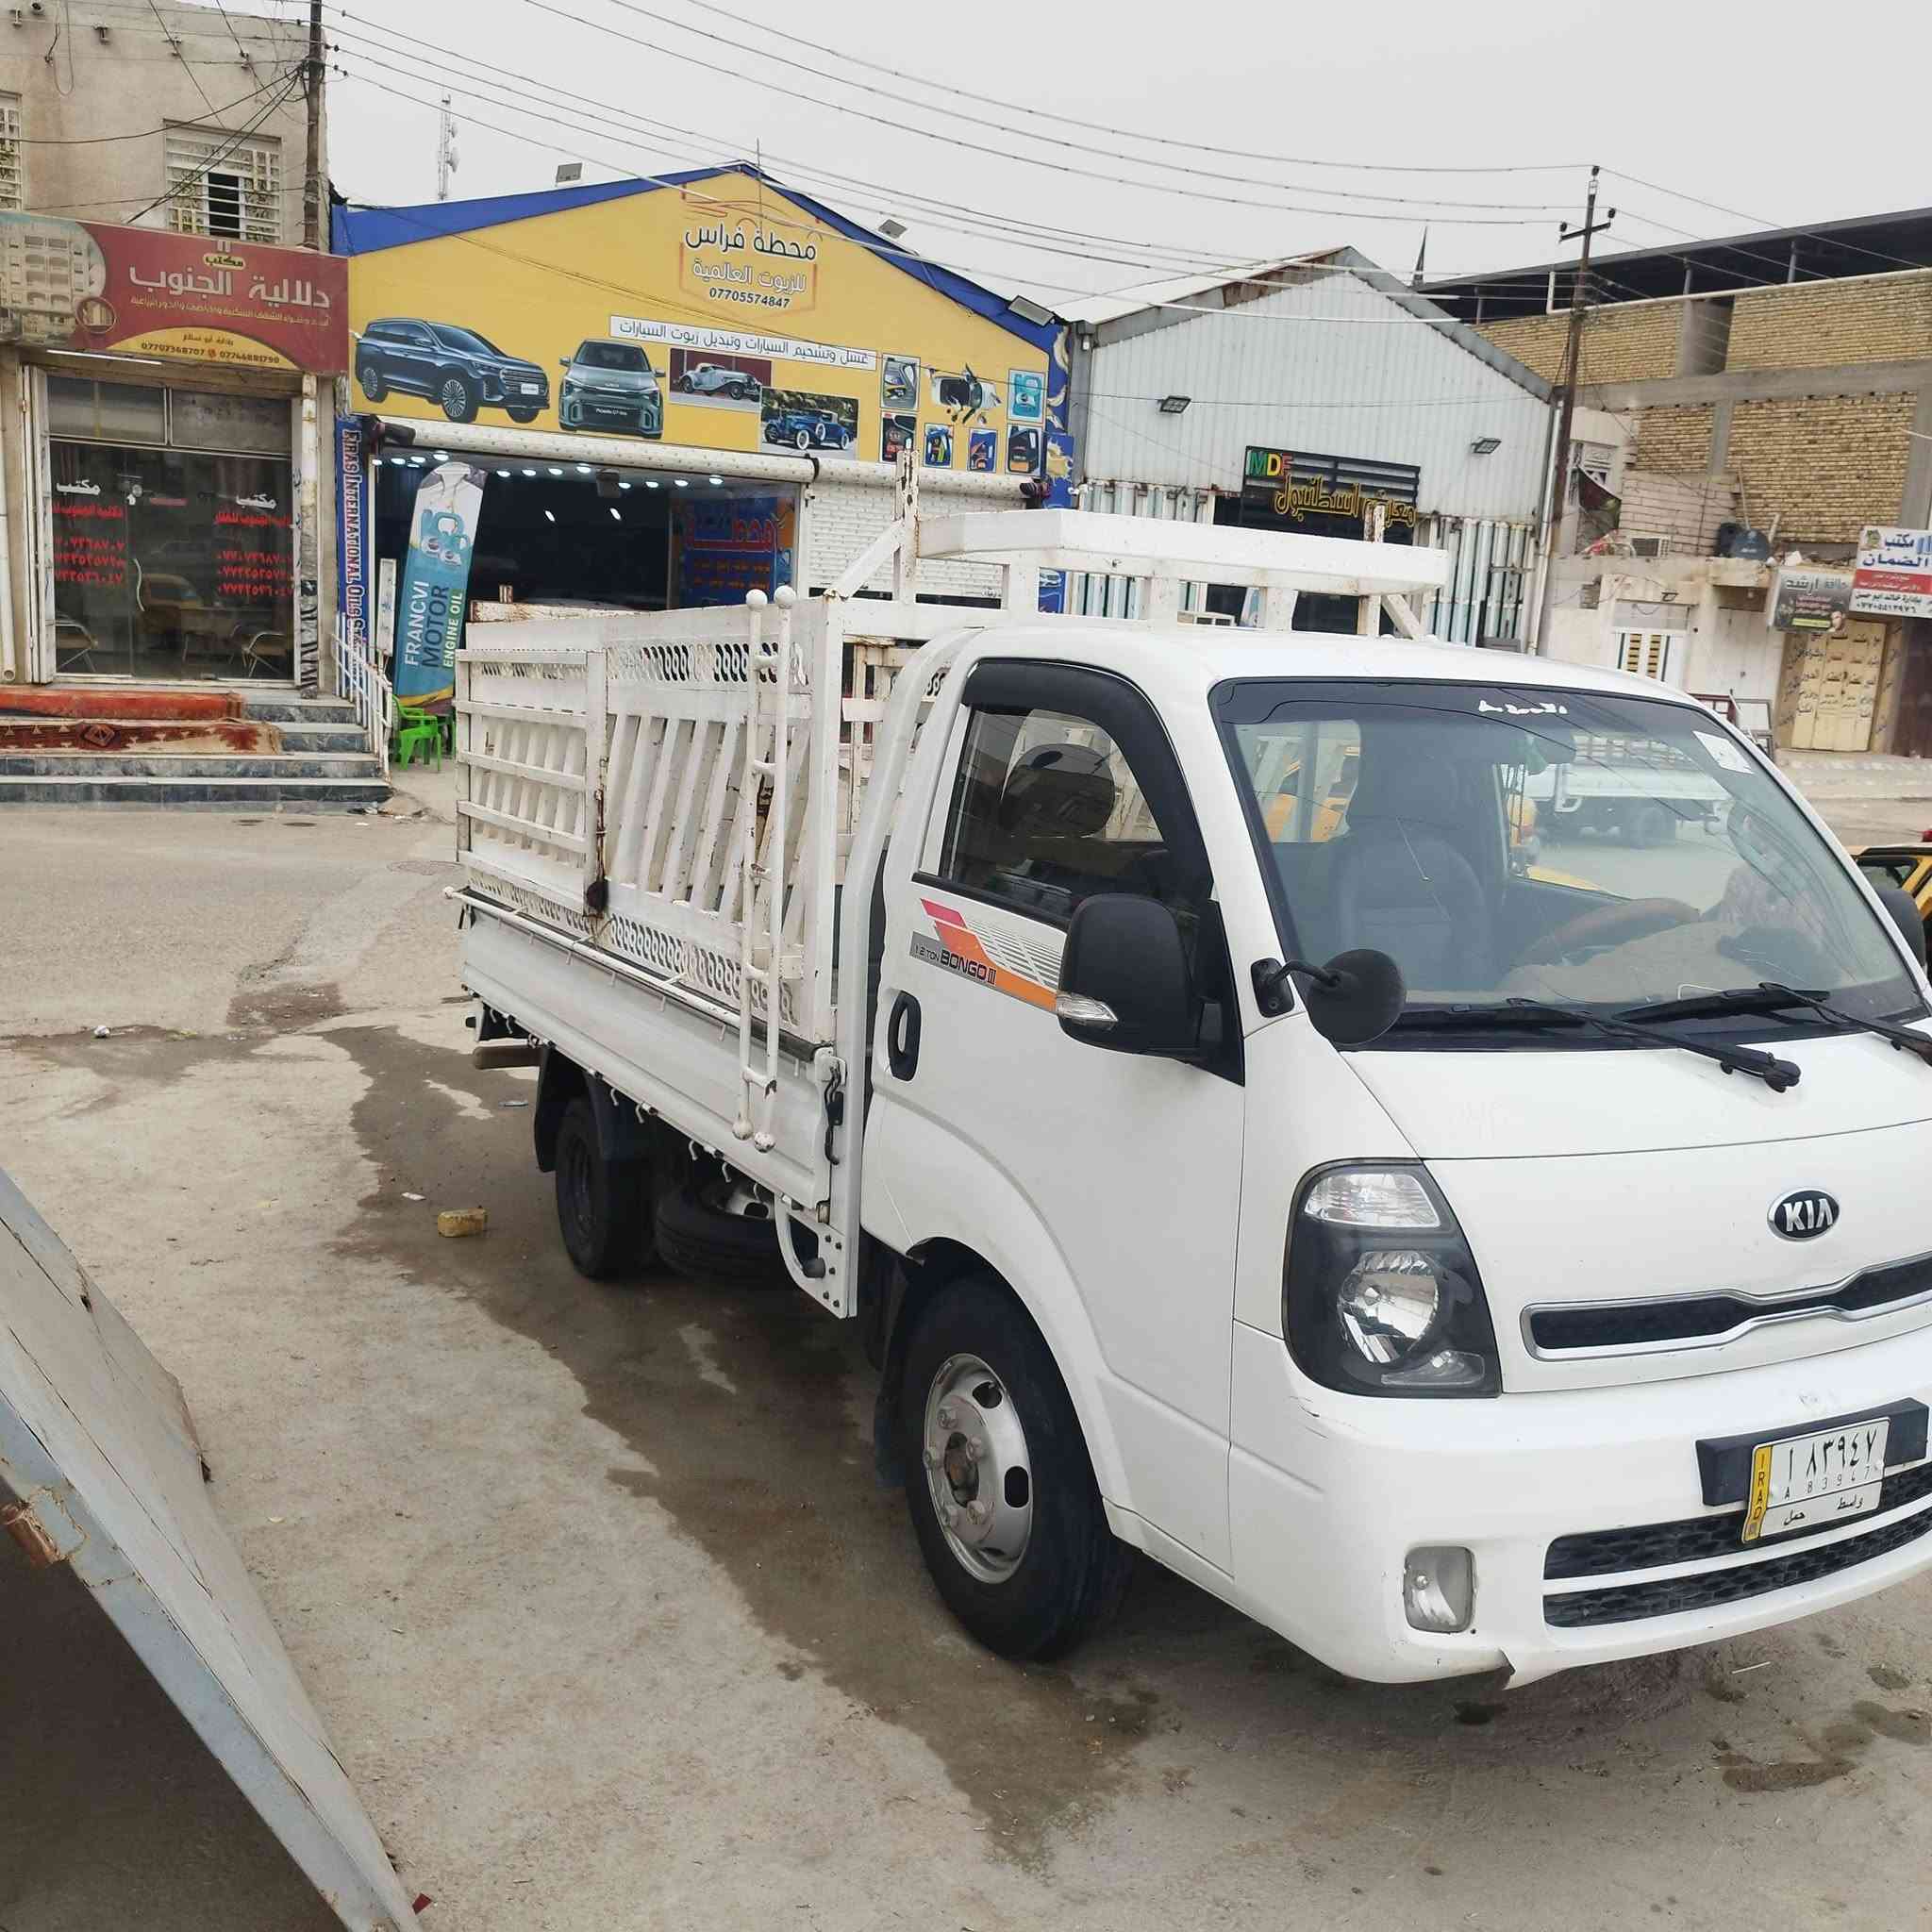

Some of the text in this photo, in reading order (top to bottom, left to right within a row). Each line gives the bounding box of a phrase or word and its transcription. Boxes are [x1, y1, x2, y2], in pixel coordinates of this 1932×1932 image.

[685, 224, 817, 260] محطة فراس
[206, 256, 243, 268] مكتب
[693, 258, 753, 283] العالمية
[129, 264, 232, 297] الجنوب
[708, 287, 791, 309] 07705574847
[619, 320, 667, 338] السيارات
[703, 331, 741, 350] وتبديل
[745, 336, 789, 354] السيارات
[840, 352, 869, 365] غسل
[56, 479, 101, 496] مكتب
[235, 492, 277, 510] مكتب
[1884, 533, 1915, 551] مكتب
[1863, 552, 1928, 567] الضمان
[422, 585, 450, 668] MOTOR
[442, 591, 463, 669] ENGINE OIL
[940, 949, 988, 980] BONGO
[1782, 1198, 1834, 1231] KIA
